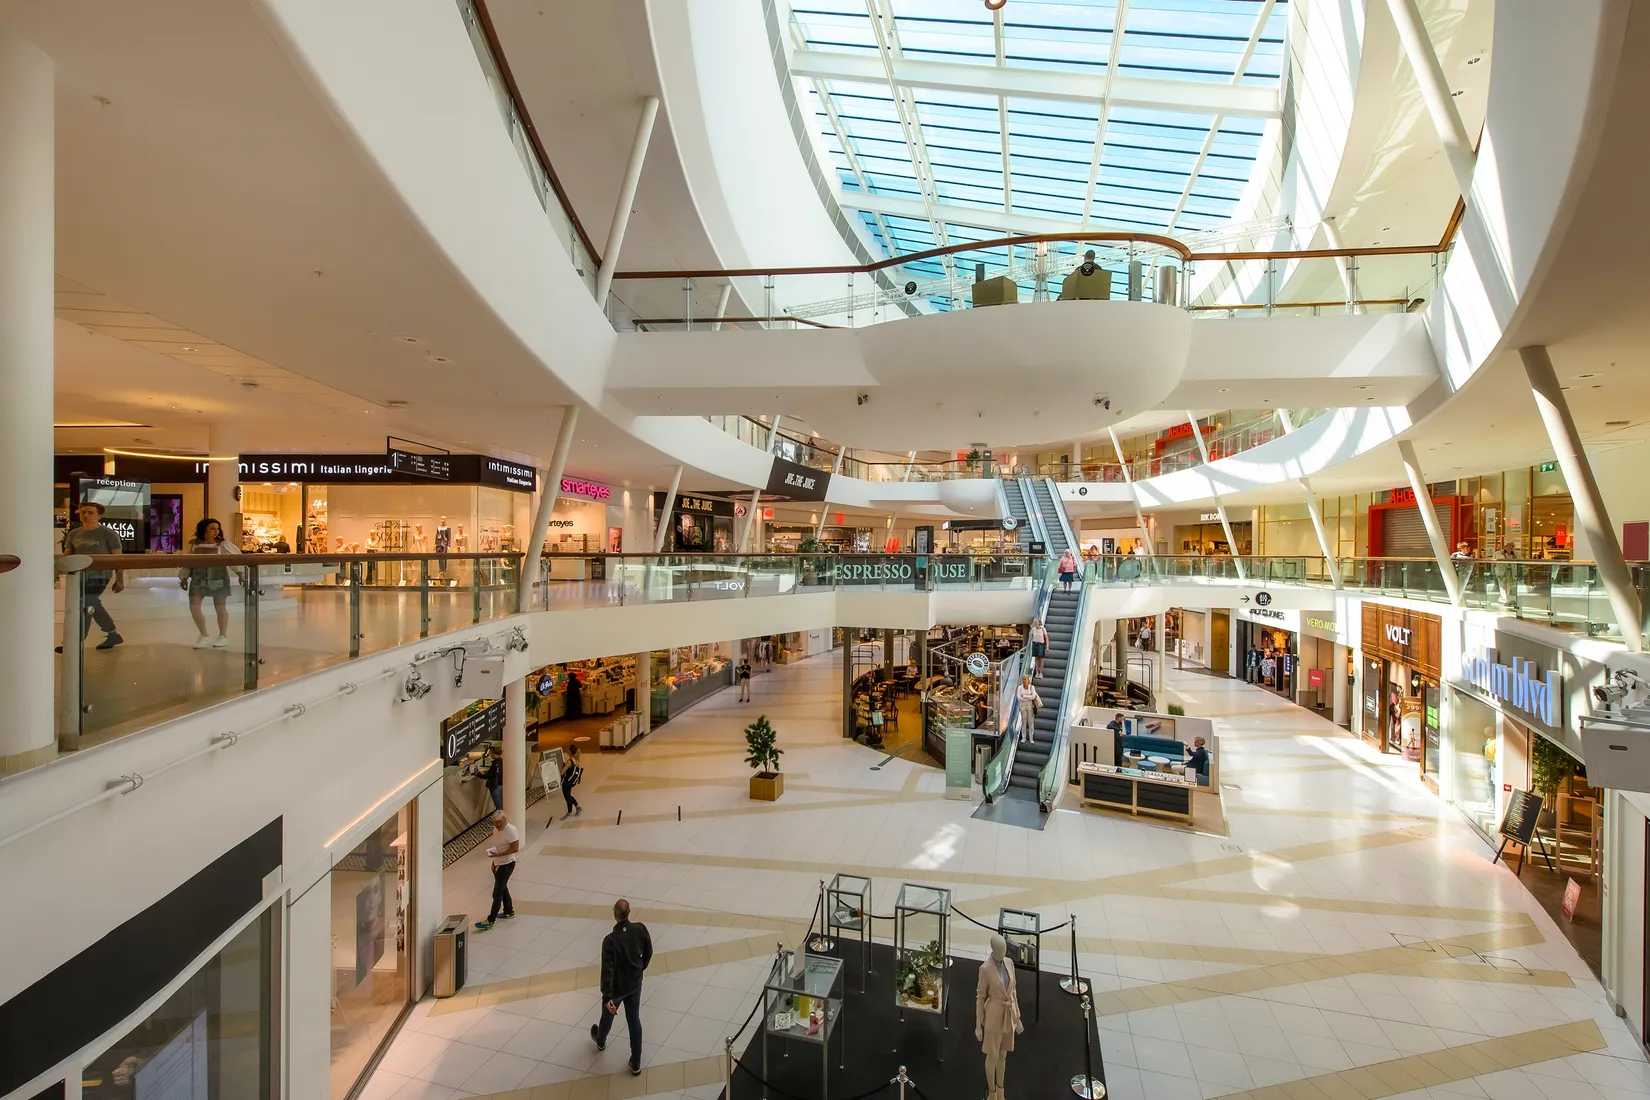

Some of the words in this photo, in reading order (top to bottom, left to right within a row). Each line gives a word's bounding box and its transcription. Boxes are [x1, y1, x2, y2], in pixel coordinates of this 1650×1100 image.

[320, 464, 351, 474] Italian
[488, 461, 533, 478] intimissimi
[96, 477, 136, 488] reception
[561, 478, 611, 500] smarteyes
[784, 472, 795, 485] JOE
[795, 474, 804, 487] THE
[802, 477, 816, 490] JUICE
[682, 497, 690, 508] JOE
[701, 499, 713, 511] JUICE
[1389, 487, 1415, 504] ÅHLÉ
[548, 519, 574, 529] arteyes
[834, 563, 912, 580] ESPRESSO
[934, 563, 966, 579] USE
[1306, 616, 1324, 629] VERO
[1385, 623, 1411, 646] VOLT
[1512, 655, 1558, 728] blvd
